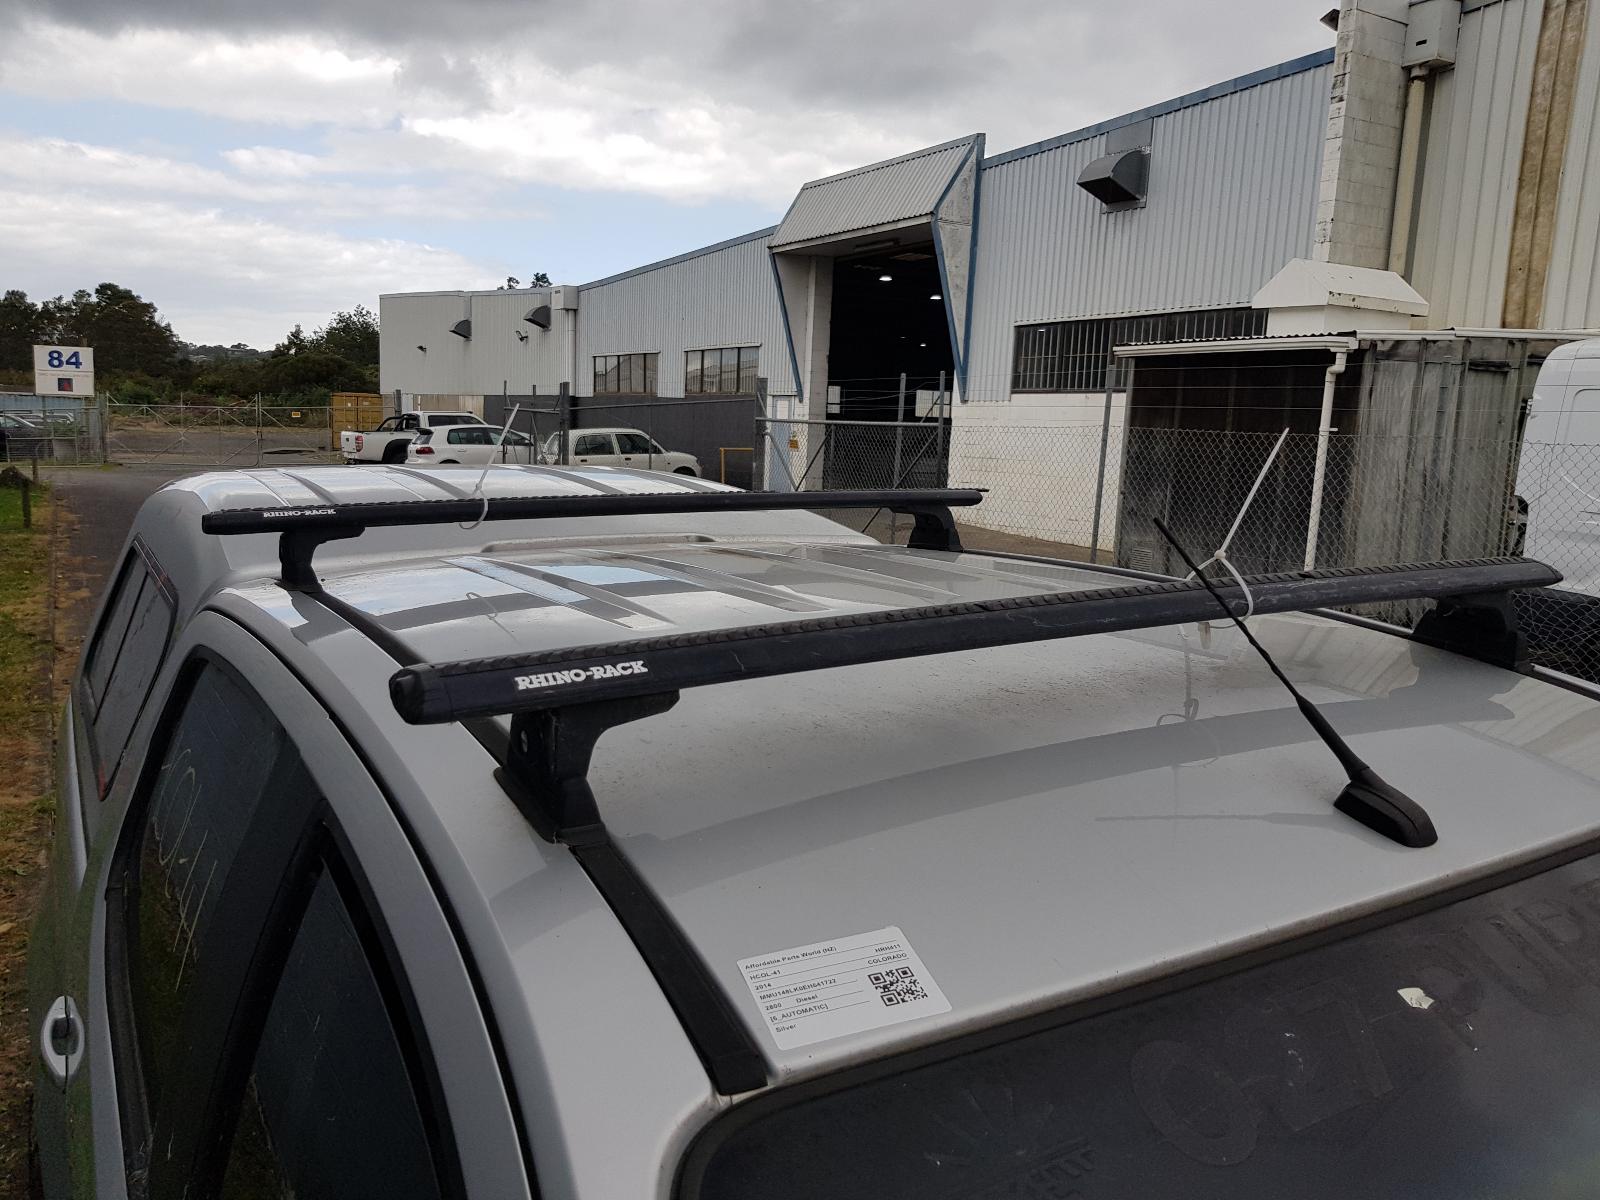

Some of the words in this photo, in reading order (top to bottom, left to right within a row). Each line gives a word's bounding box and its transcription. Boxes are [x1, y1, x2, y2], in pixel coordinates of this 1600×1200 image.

[48, 350, 83, 369] 84
[263, 509, 337, 518] RHINO-RACK
[514, 660, 649, 690] RHINO-RACK
[745, 959, 781, 970] Affordable
[782, 954, 800, 962] Parts
[801, 949, 822, 958] World
[822, 946, 837, 954] (NZ)
[867, 952, 907, 965] COLORADO
[749, 969, 781, 981] HCOL-41
[754, 982, 772, 991] 2014
[765, 1002, 782, 1011] 2800
[796, 994, 818, 1003] Diesel
[776, 1023, 797, 1033] Silver
